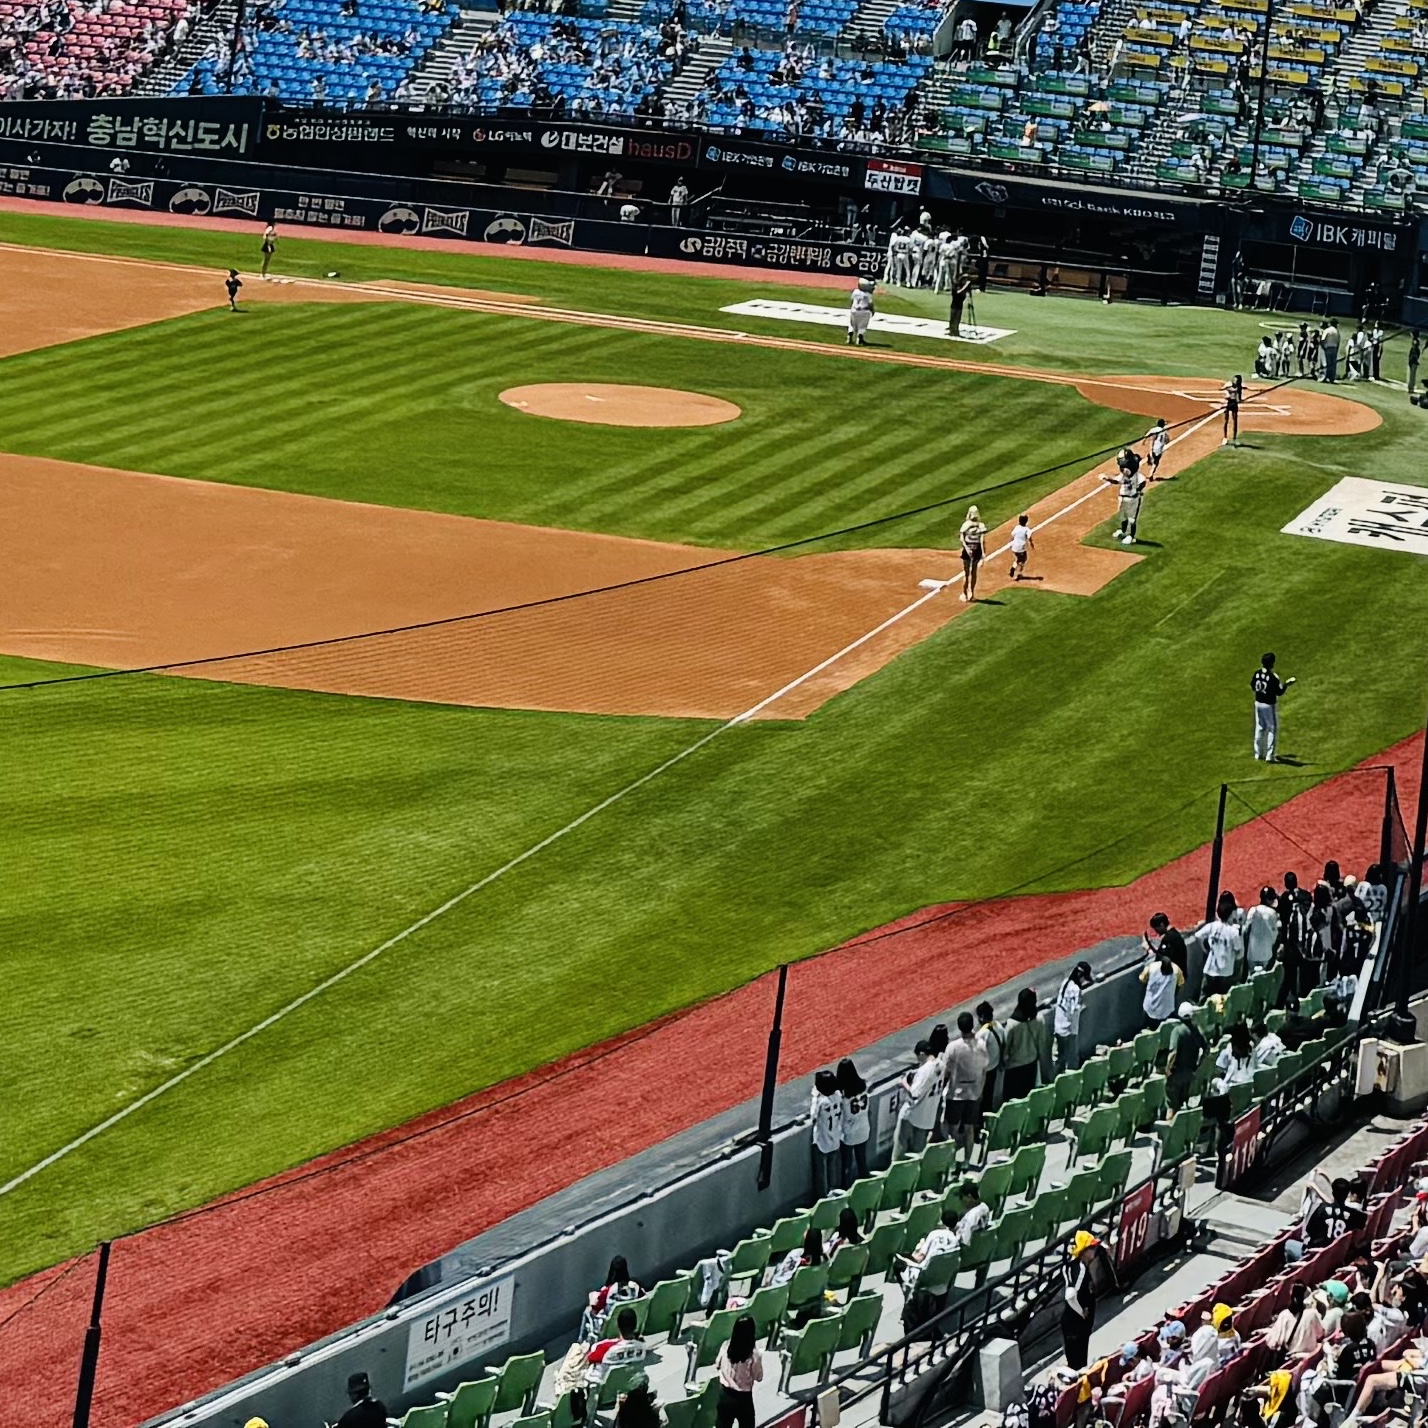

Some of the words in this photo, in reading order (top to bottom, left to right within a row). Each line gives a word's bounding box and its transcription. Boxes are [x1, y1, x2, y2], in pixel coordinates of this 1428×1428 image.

[86, 114, 249, 154] 충남혁신도시
[561, 131, 624, 155] 대보건설
[702, 236, 748, 259] 금강주택
[1231, 1134, 1259, 1183] 118
[1121, 1210, 1148, 1262] 119
[1324, 1216, 1348, 1240] 18
[424, 1286, 501, 1345] 타구주의!
